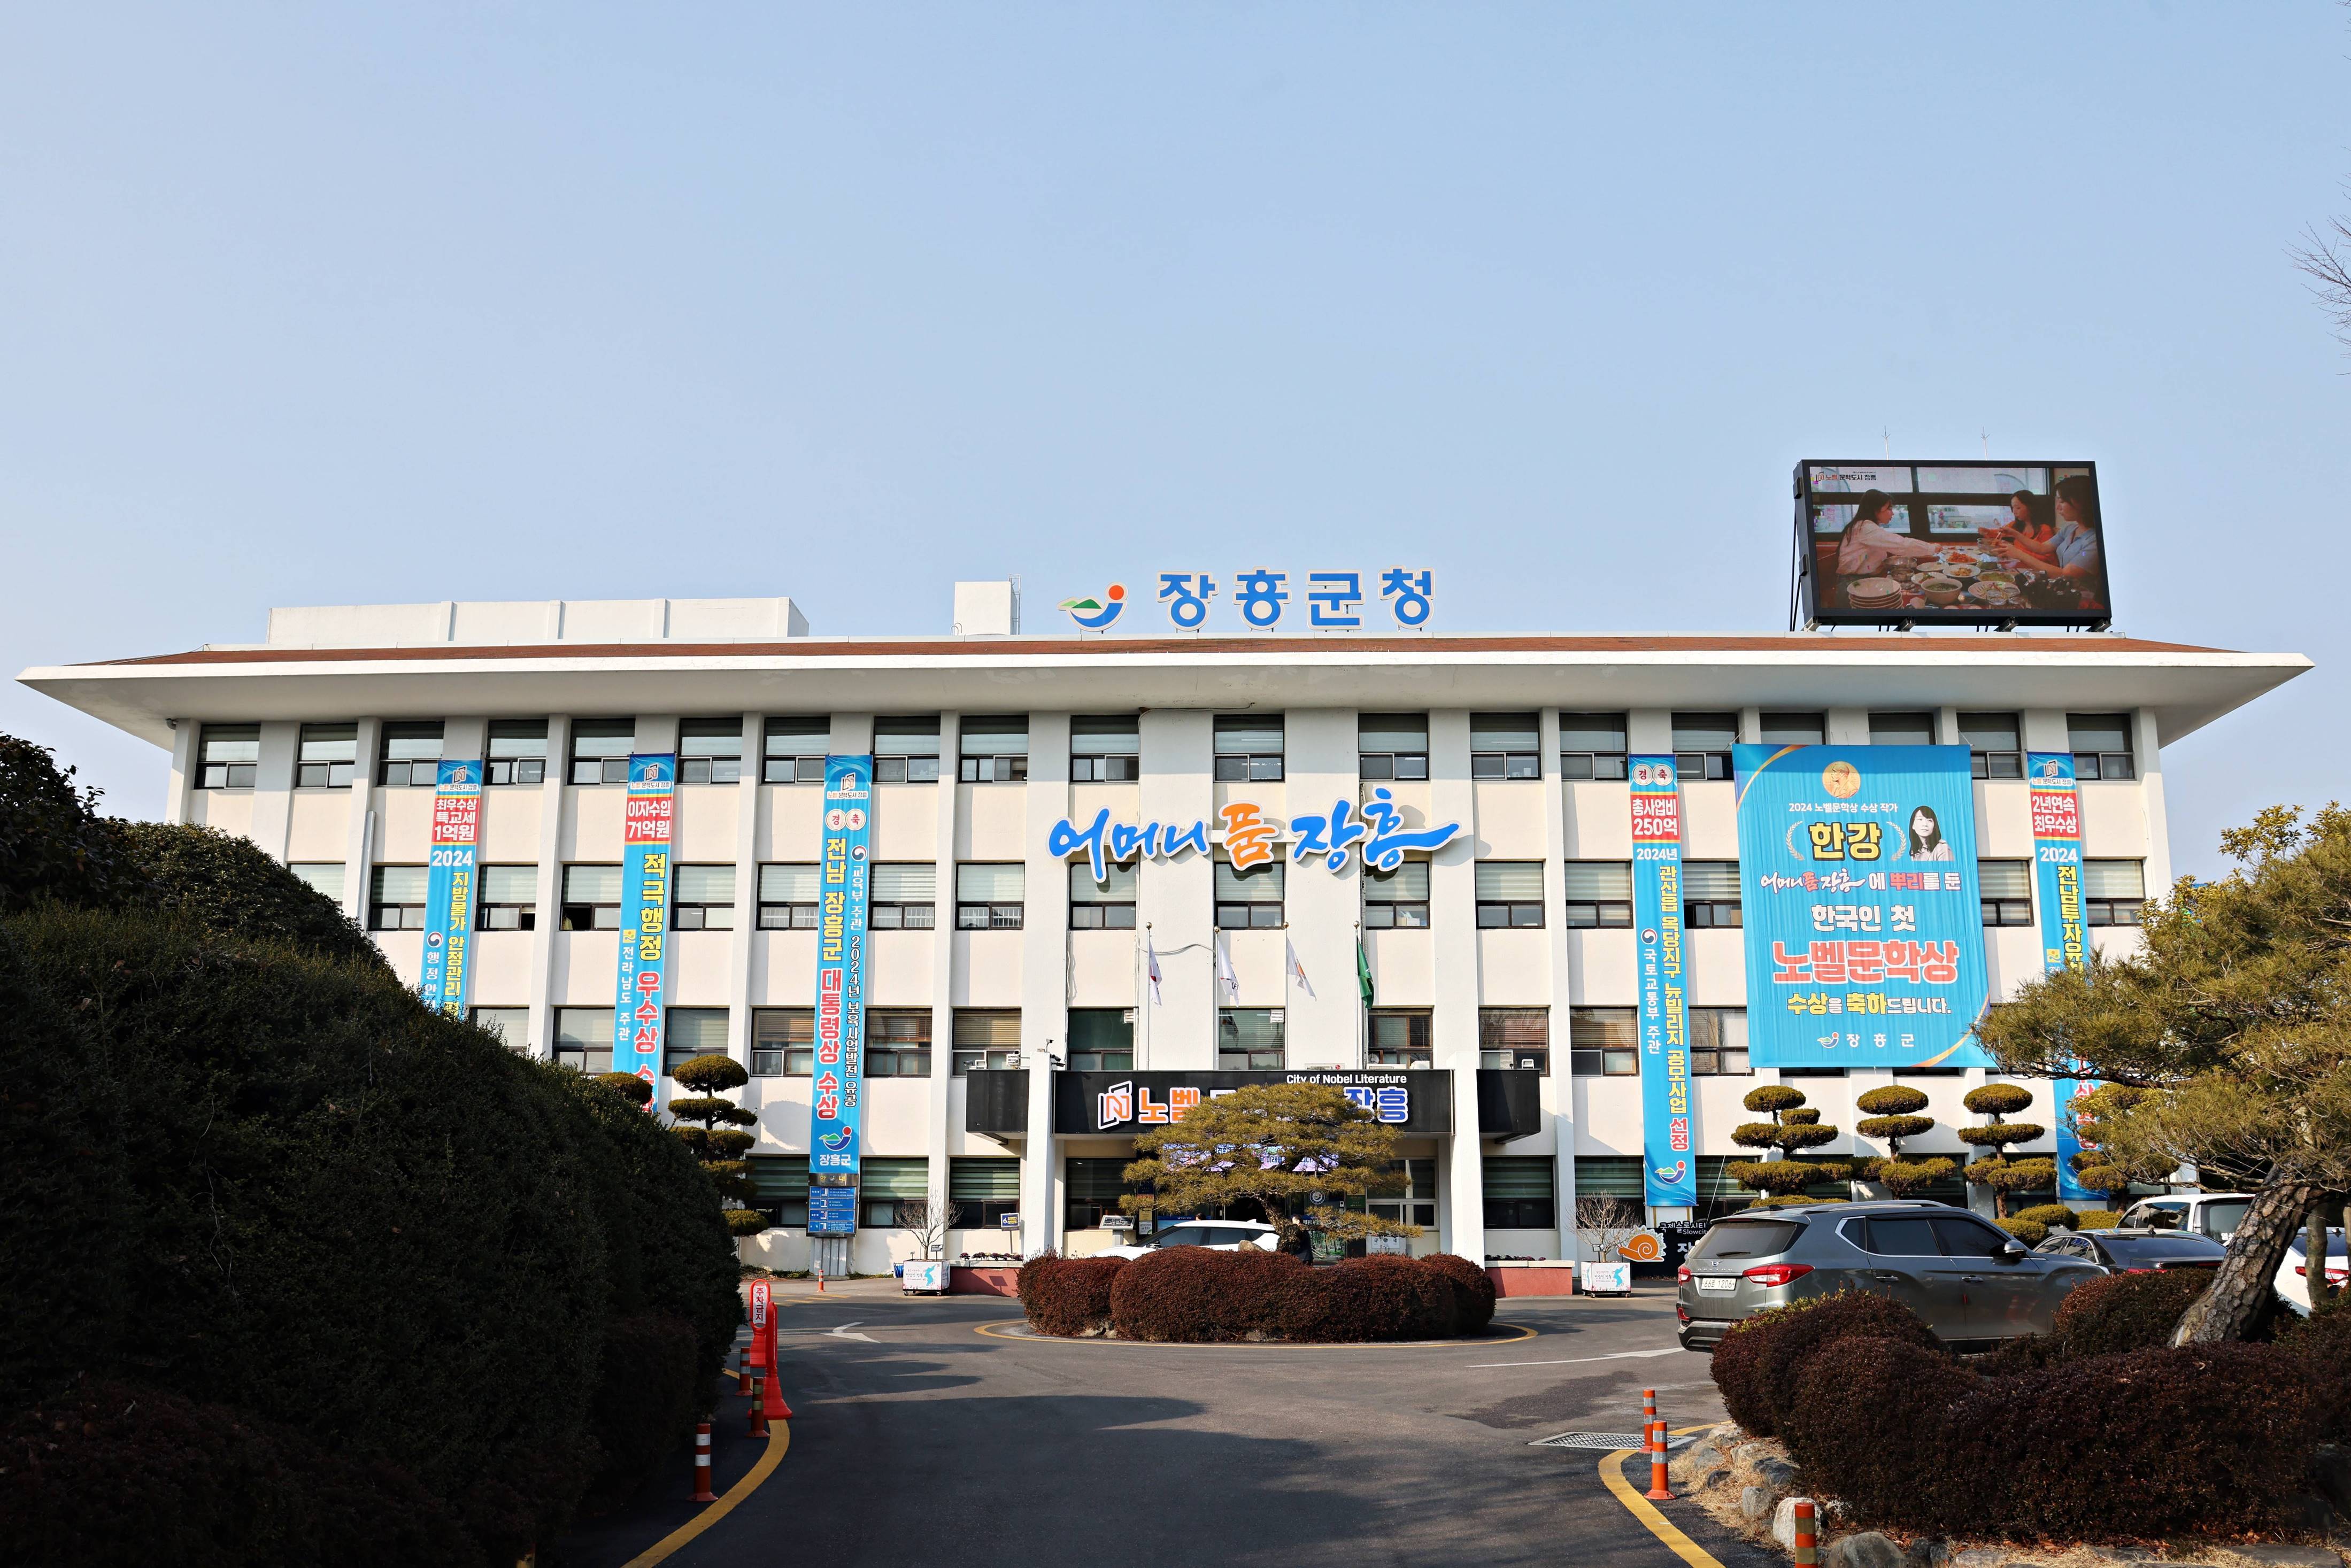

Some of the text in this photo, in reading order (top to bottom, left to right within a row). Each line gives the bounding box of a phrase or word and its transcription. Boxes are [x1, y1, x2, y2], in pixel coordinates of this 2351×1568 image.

[1157, 566, 1435, 632] 장흥군청
[436, 799, 477, 810] 최우수상
[628, 800, 671, 817] 이자수입
[1632, 799, 1676, 816] 총사업비
[1789, 802, 1898, 813] 2024 노벨문학상 수상 작가
[2032, 795, 2075, 814] 2년연속
[436, 812, 475, 823] 특교세
[627, 820, 670, 838] 71억원
[1634, 818, 1677, 836] 250억
[2034, 815, 2077, 833] 최우수상
[435, 824, 474, 841] 1억원
[1046, 785, 1462, 883] 어머니 품 장흥
[1808, 822, 1883, 861] 한강
[432, 850, 473, 867] 2024
[1637, 848, 1677, 860] 2024년
[2040, 847, 2078, 862] 2024
[1760, 870, 1803, 894] 어머니
[1821, 868, 1865, 893] 장흥
[1869, 872, 1886, 891] 에
[1890, 871, 1940, 891] 뿌리를
[1944, 872, 1961, 891] 둔
[449, 871, 469, 931] 지방물가
[639, 853, 667, 961] 적극행정
[1811, 904, 1916, 932] 한국인 첫
[444, 936, 465, 997] 안정관리
[1772, 939, 1959, 984] 노벨문학상
[816, 838, 847, 1120] 전남 장흥군 대통령상 수상
[843, 866, 865, 1107] 교육부 주관 2024년 보육사업발전 유공
[618, 946, 634, 1041] 전라남도 주관
[1644, 949, 1661, 1054] 국토교통부 주관
[1787, 992, 1952, 1015] 수상을 축하드립니다.
[634, 971, 660, 1054] 우수상
[1659, 866, 1689, 1151] 관산읍 옥당지구 뉴빌리지 공모사업 선정
[1286, 1074, 1407, 1084] City of Nobel Literature
[1138, 1087, 1200, 1123] 노벨
[819, 1154, 851, 1166] 장흥군
[1660, 1222, 1706, 1233] 국제슬로시티
[1718, 1280, 1732, 1288] 1206
[756, 1288, 764, 1322] 주차금지
